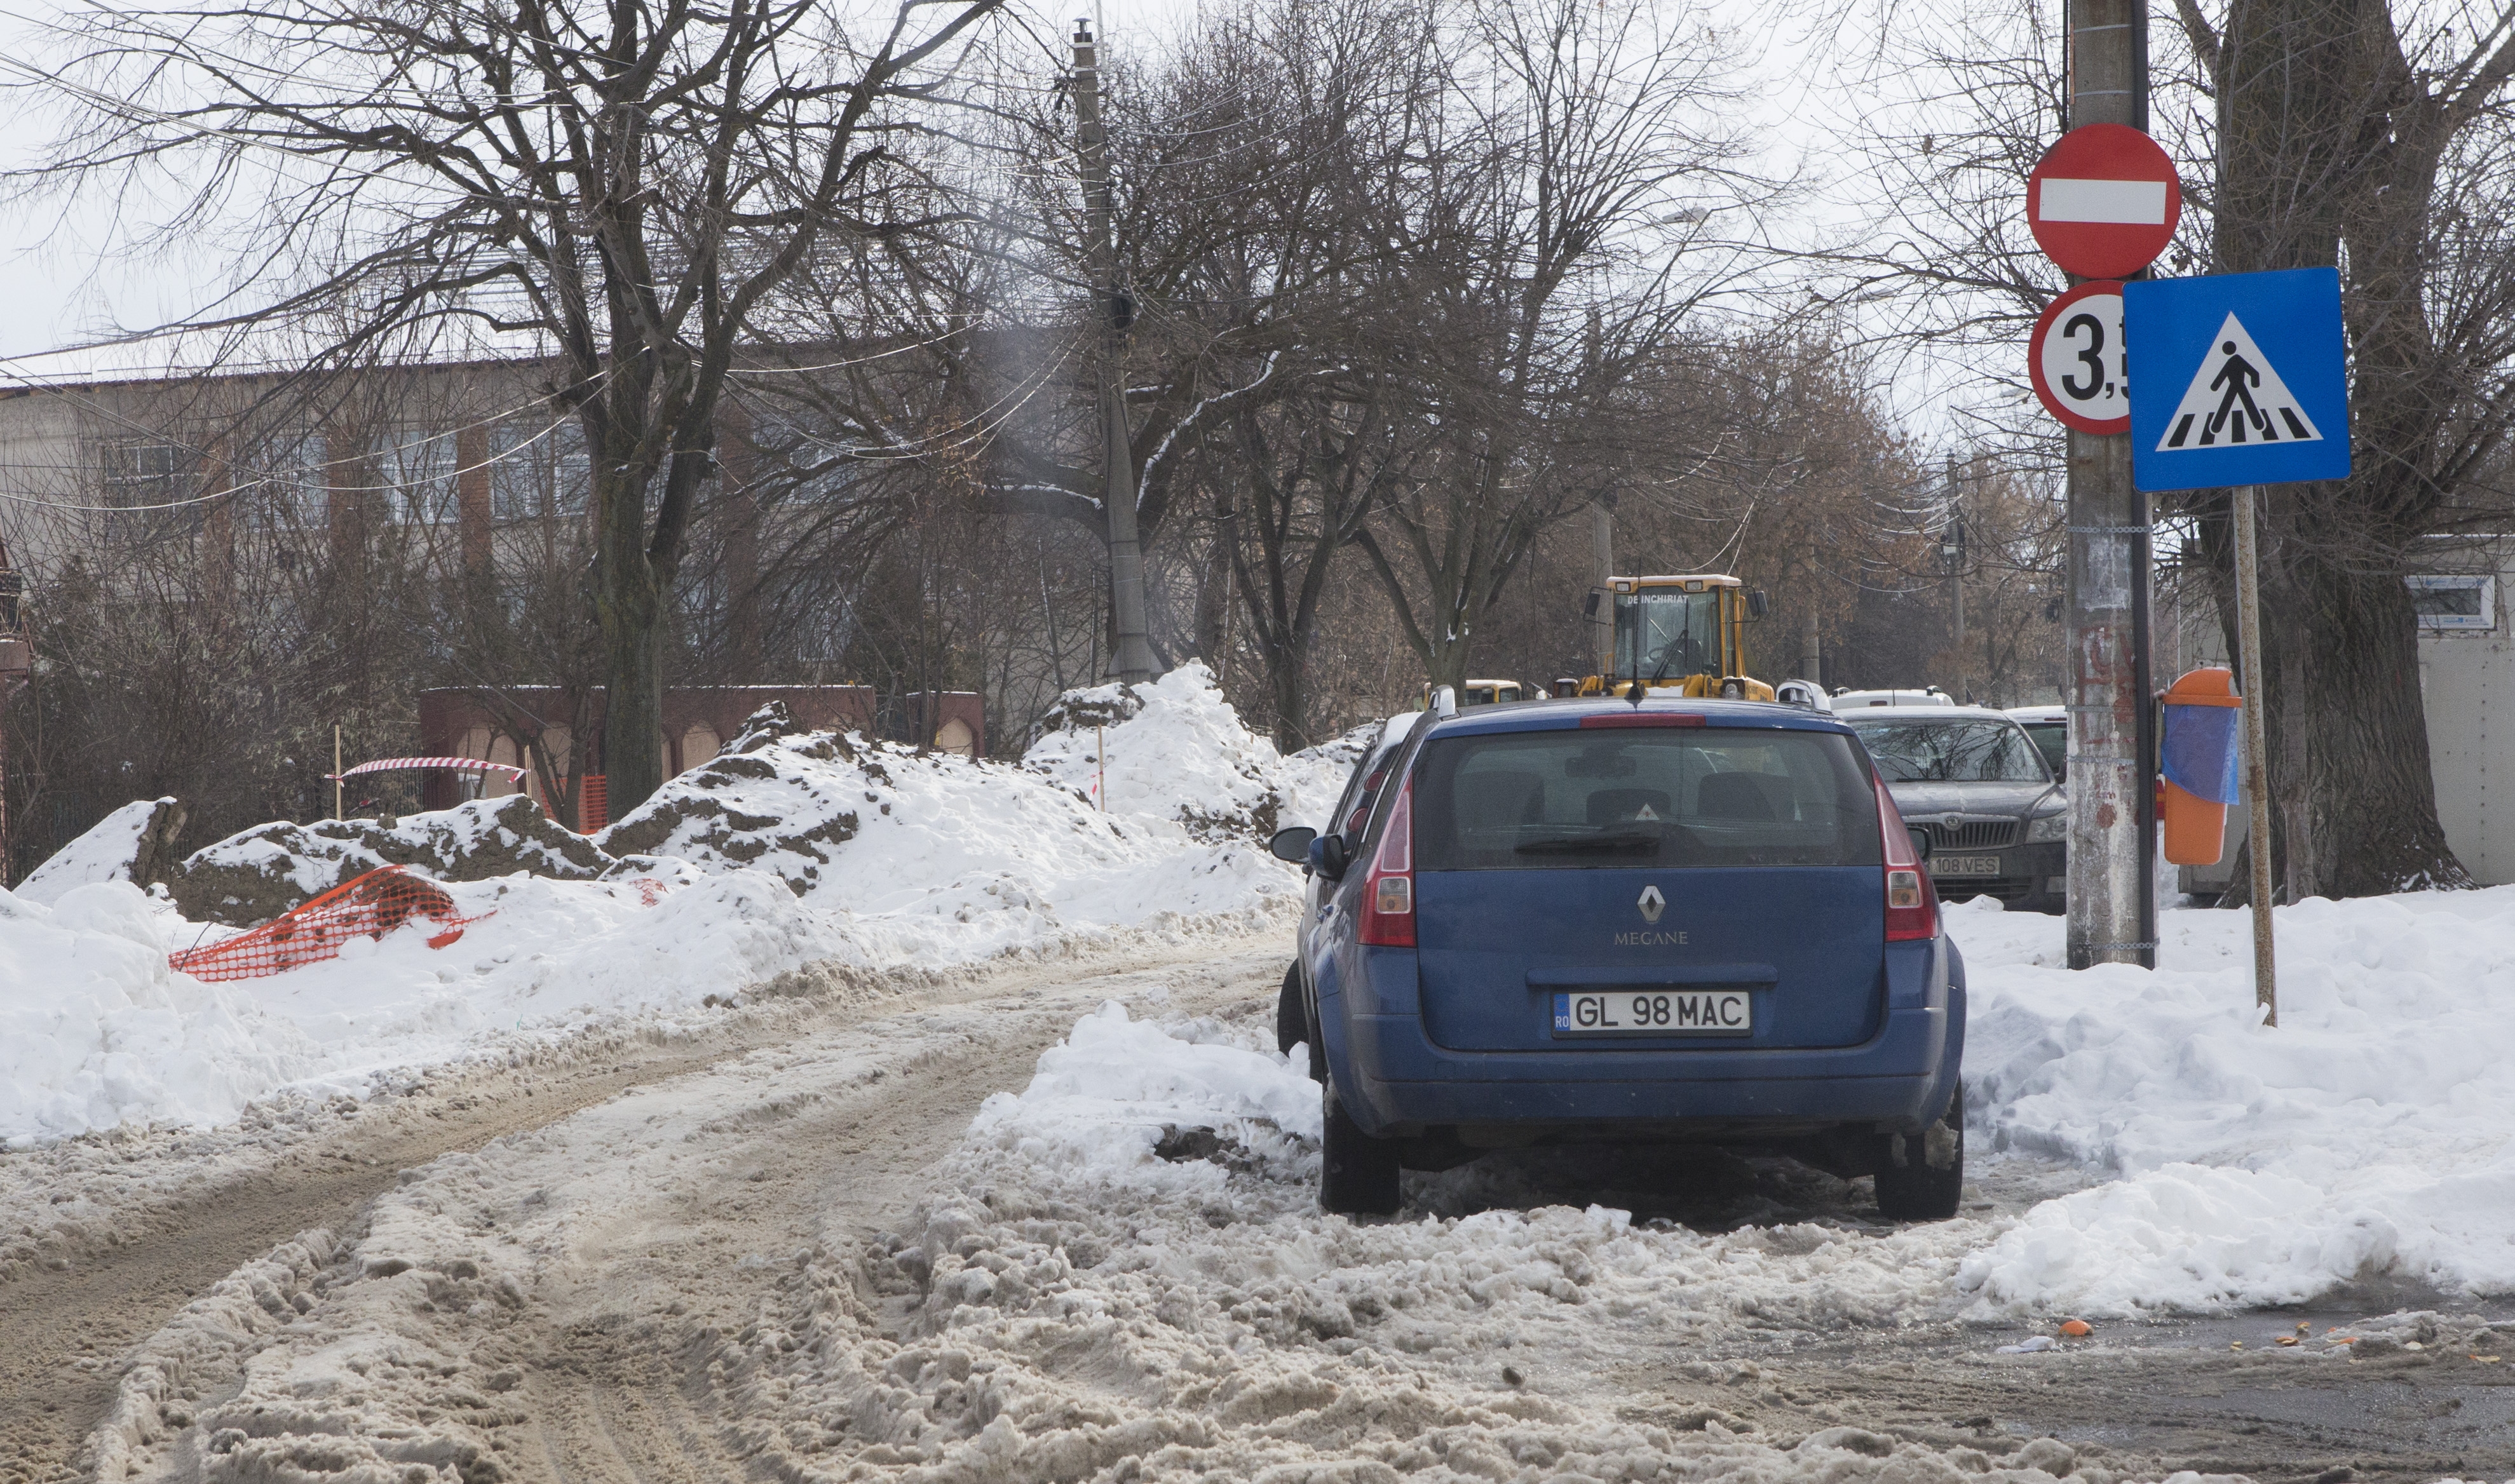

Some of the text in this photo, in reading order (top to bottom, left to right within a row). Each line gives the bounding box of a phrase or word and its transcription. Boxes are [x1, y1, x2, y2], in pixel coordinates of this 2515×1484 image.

[2062, 313, 2129, 400] 3,
[1627, 595, 1688, 605] DE INCHIRIAT
[1936, 858, 1960, 872] 108
[1963, 858, 1996, 872] VES
[1614, 932, 1688, 945] MEGANE
[1576, 996, 1742, 1027] GL 98 MAC
[1556, 1016, 1568, 1028] RO
